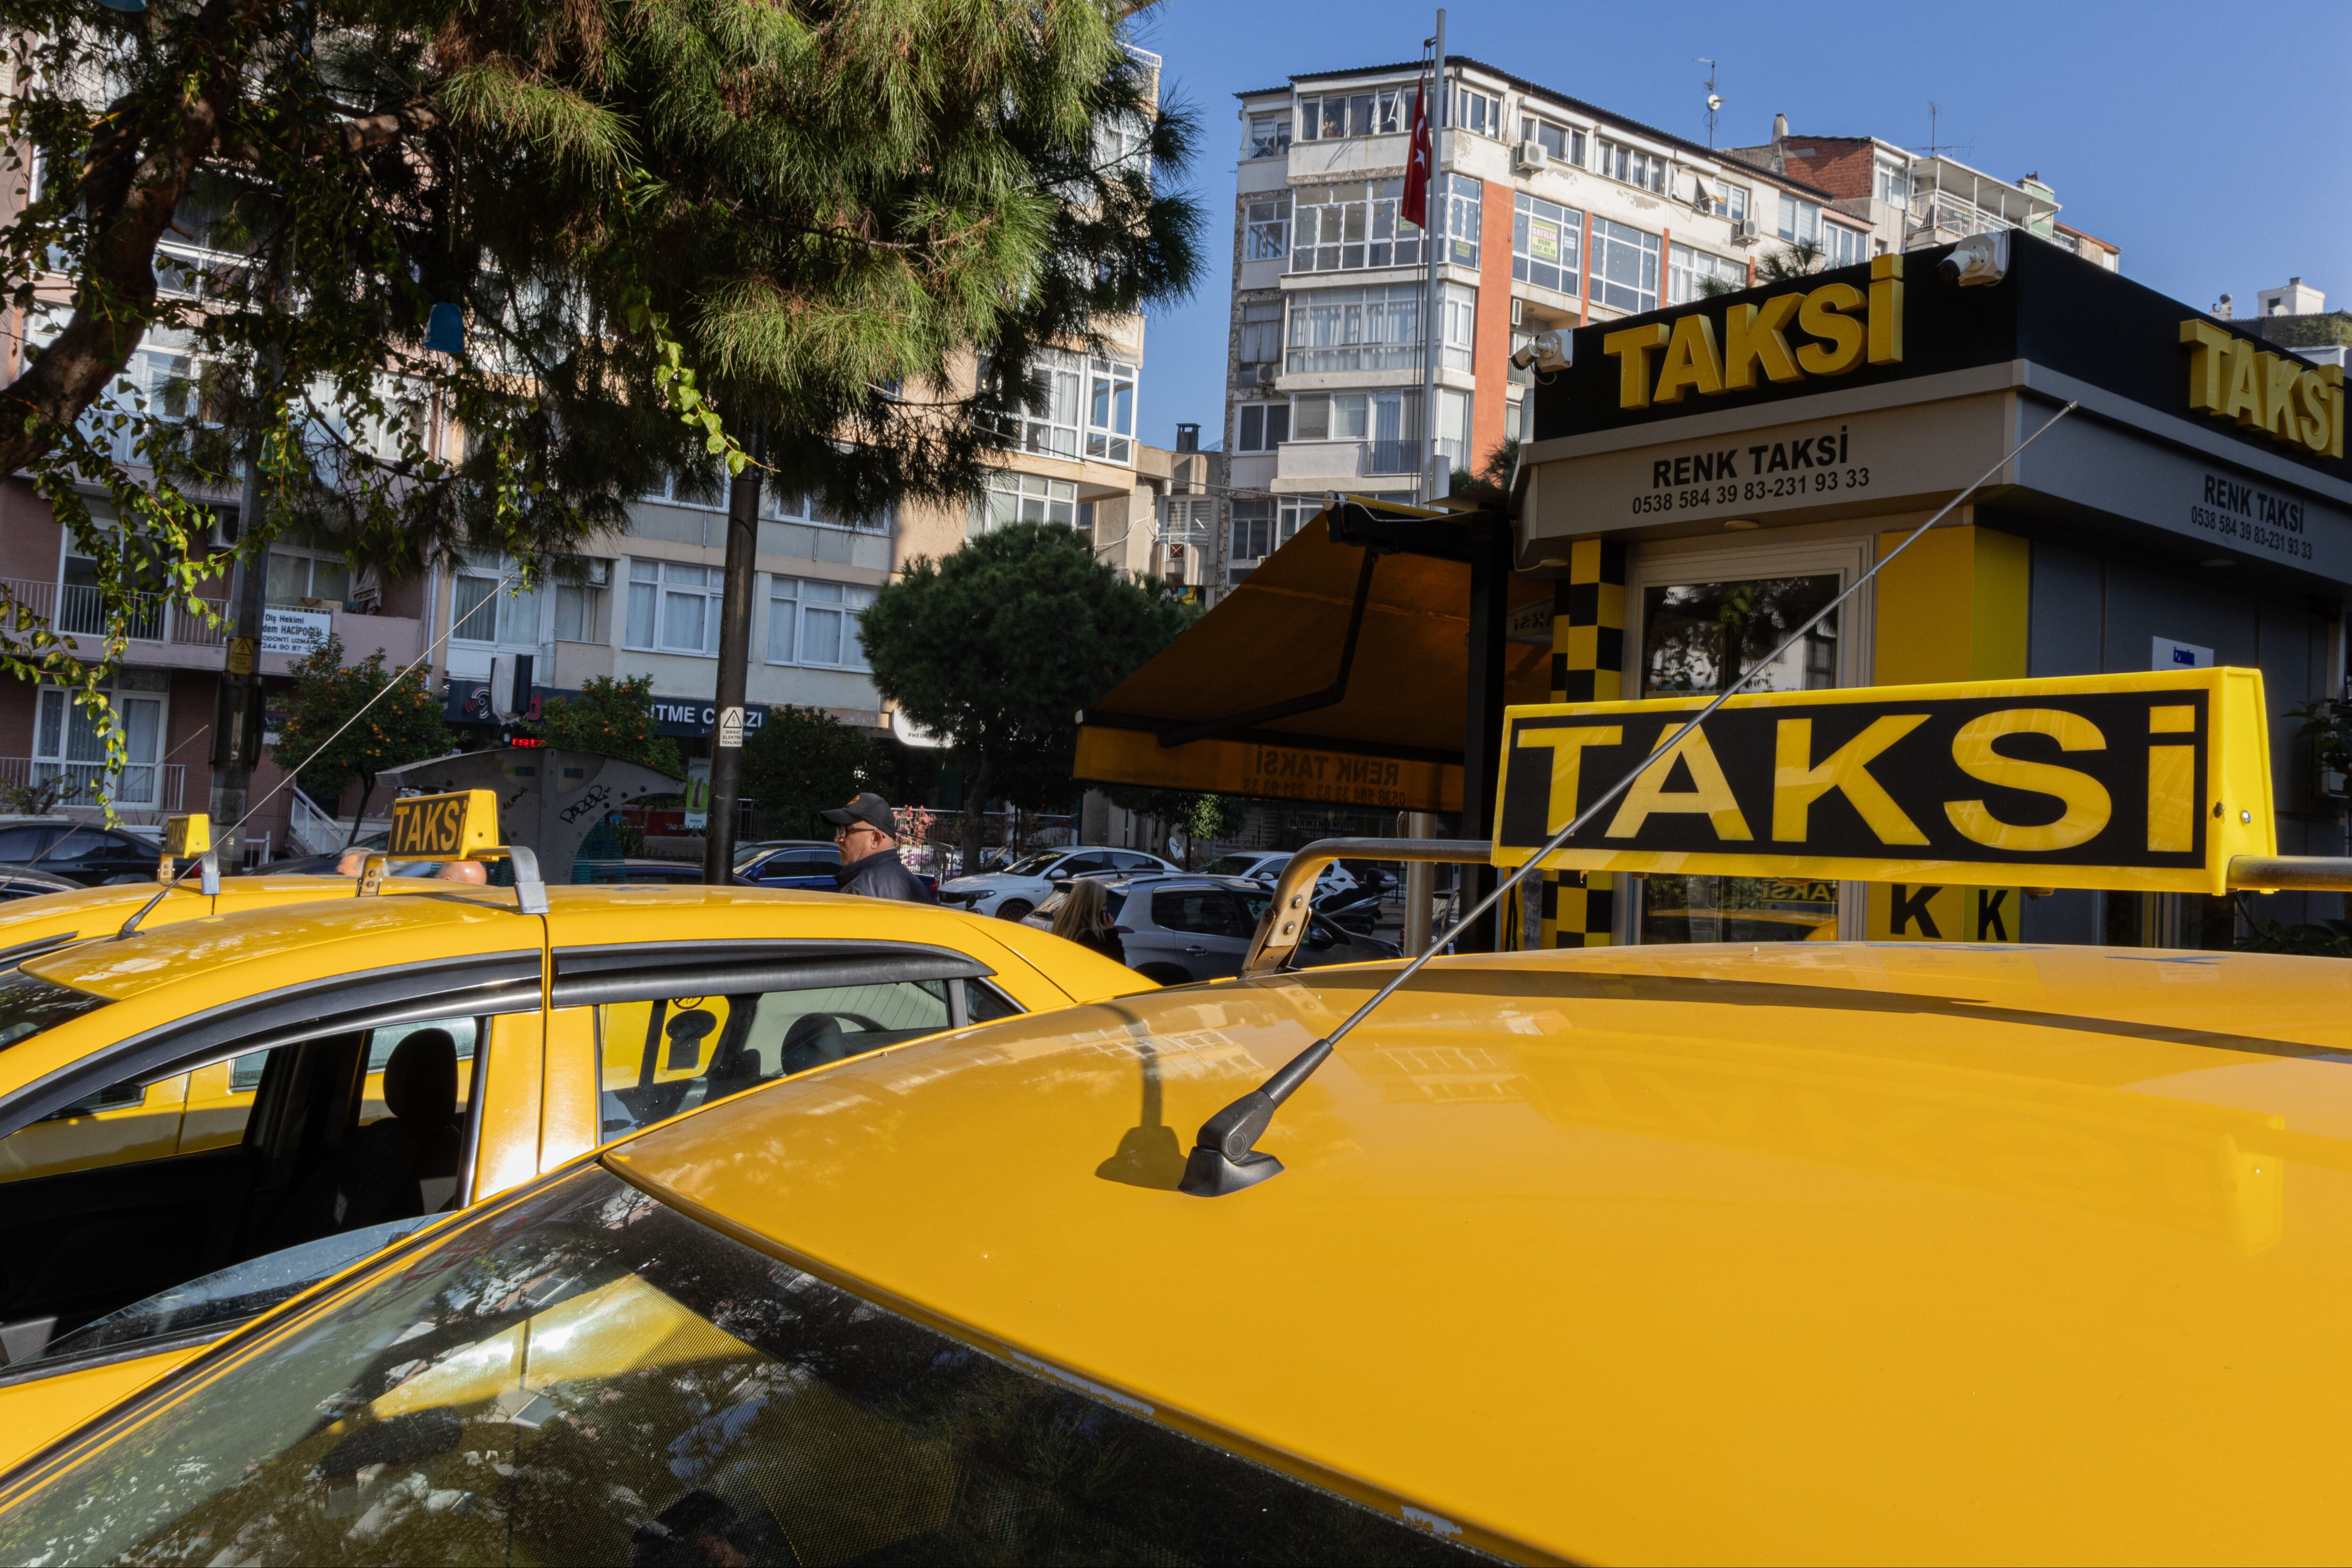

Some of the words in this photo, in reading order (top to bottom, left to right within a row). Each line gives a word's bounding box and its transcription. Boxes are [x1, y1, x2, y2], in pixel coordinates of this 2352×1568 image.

[1532, 227, 1556, 242] SATILIK
[1604, 253, 1904, 410] TAKSİ
[2180, 319, 2344, 459] TAKSİ
[1653, 449, 1738, 489] RENK
[1748, 425, 1848, 476] TAKSİ
[1632, 490, 1673, 515] 0538
[1679, 488, 1710, 509] 584
[1716, 484, 1738, 506] 39
[1743, 475, 1806, 501] 83-231
[1814, 471, 1839, 492] 93
[1846, 467, 1870, 489] 33
[2204, 474, 2252, 518] RENK
[2257, 492, 2304, 535] TAKSİ
[2191, 505, 2216, 530] 0538
[2219, 515, 2236, 536] 584
[2240, 521, 2251, 541] 39
[2254, 526, 2285, 552] 83-231
[2288, 537, 2299, 556] 93
[2302, 541, 2312, 560] 33
[262, 624, 277, 633] dem
[265, 614, 277, 623] Diş
[279, 615, 304, 624] Hekimi
[644, 704, 695, 723] İTME
[702, 708, 762, 728] CZI
[1516, 704, 2195, 852] TAKSi
